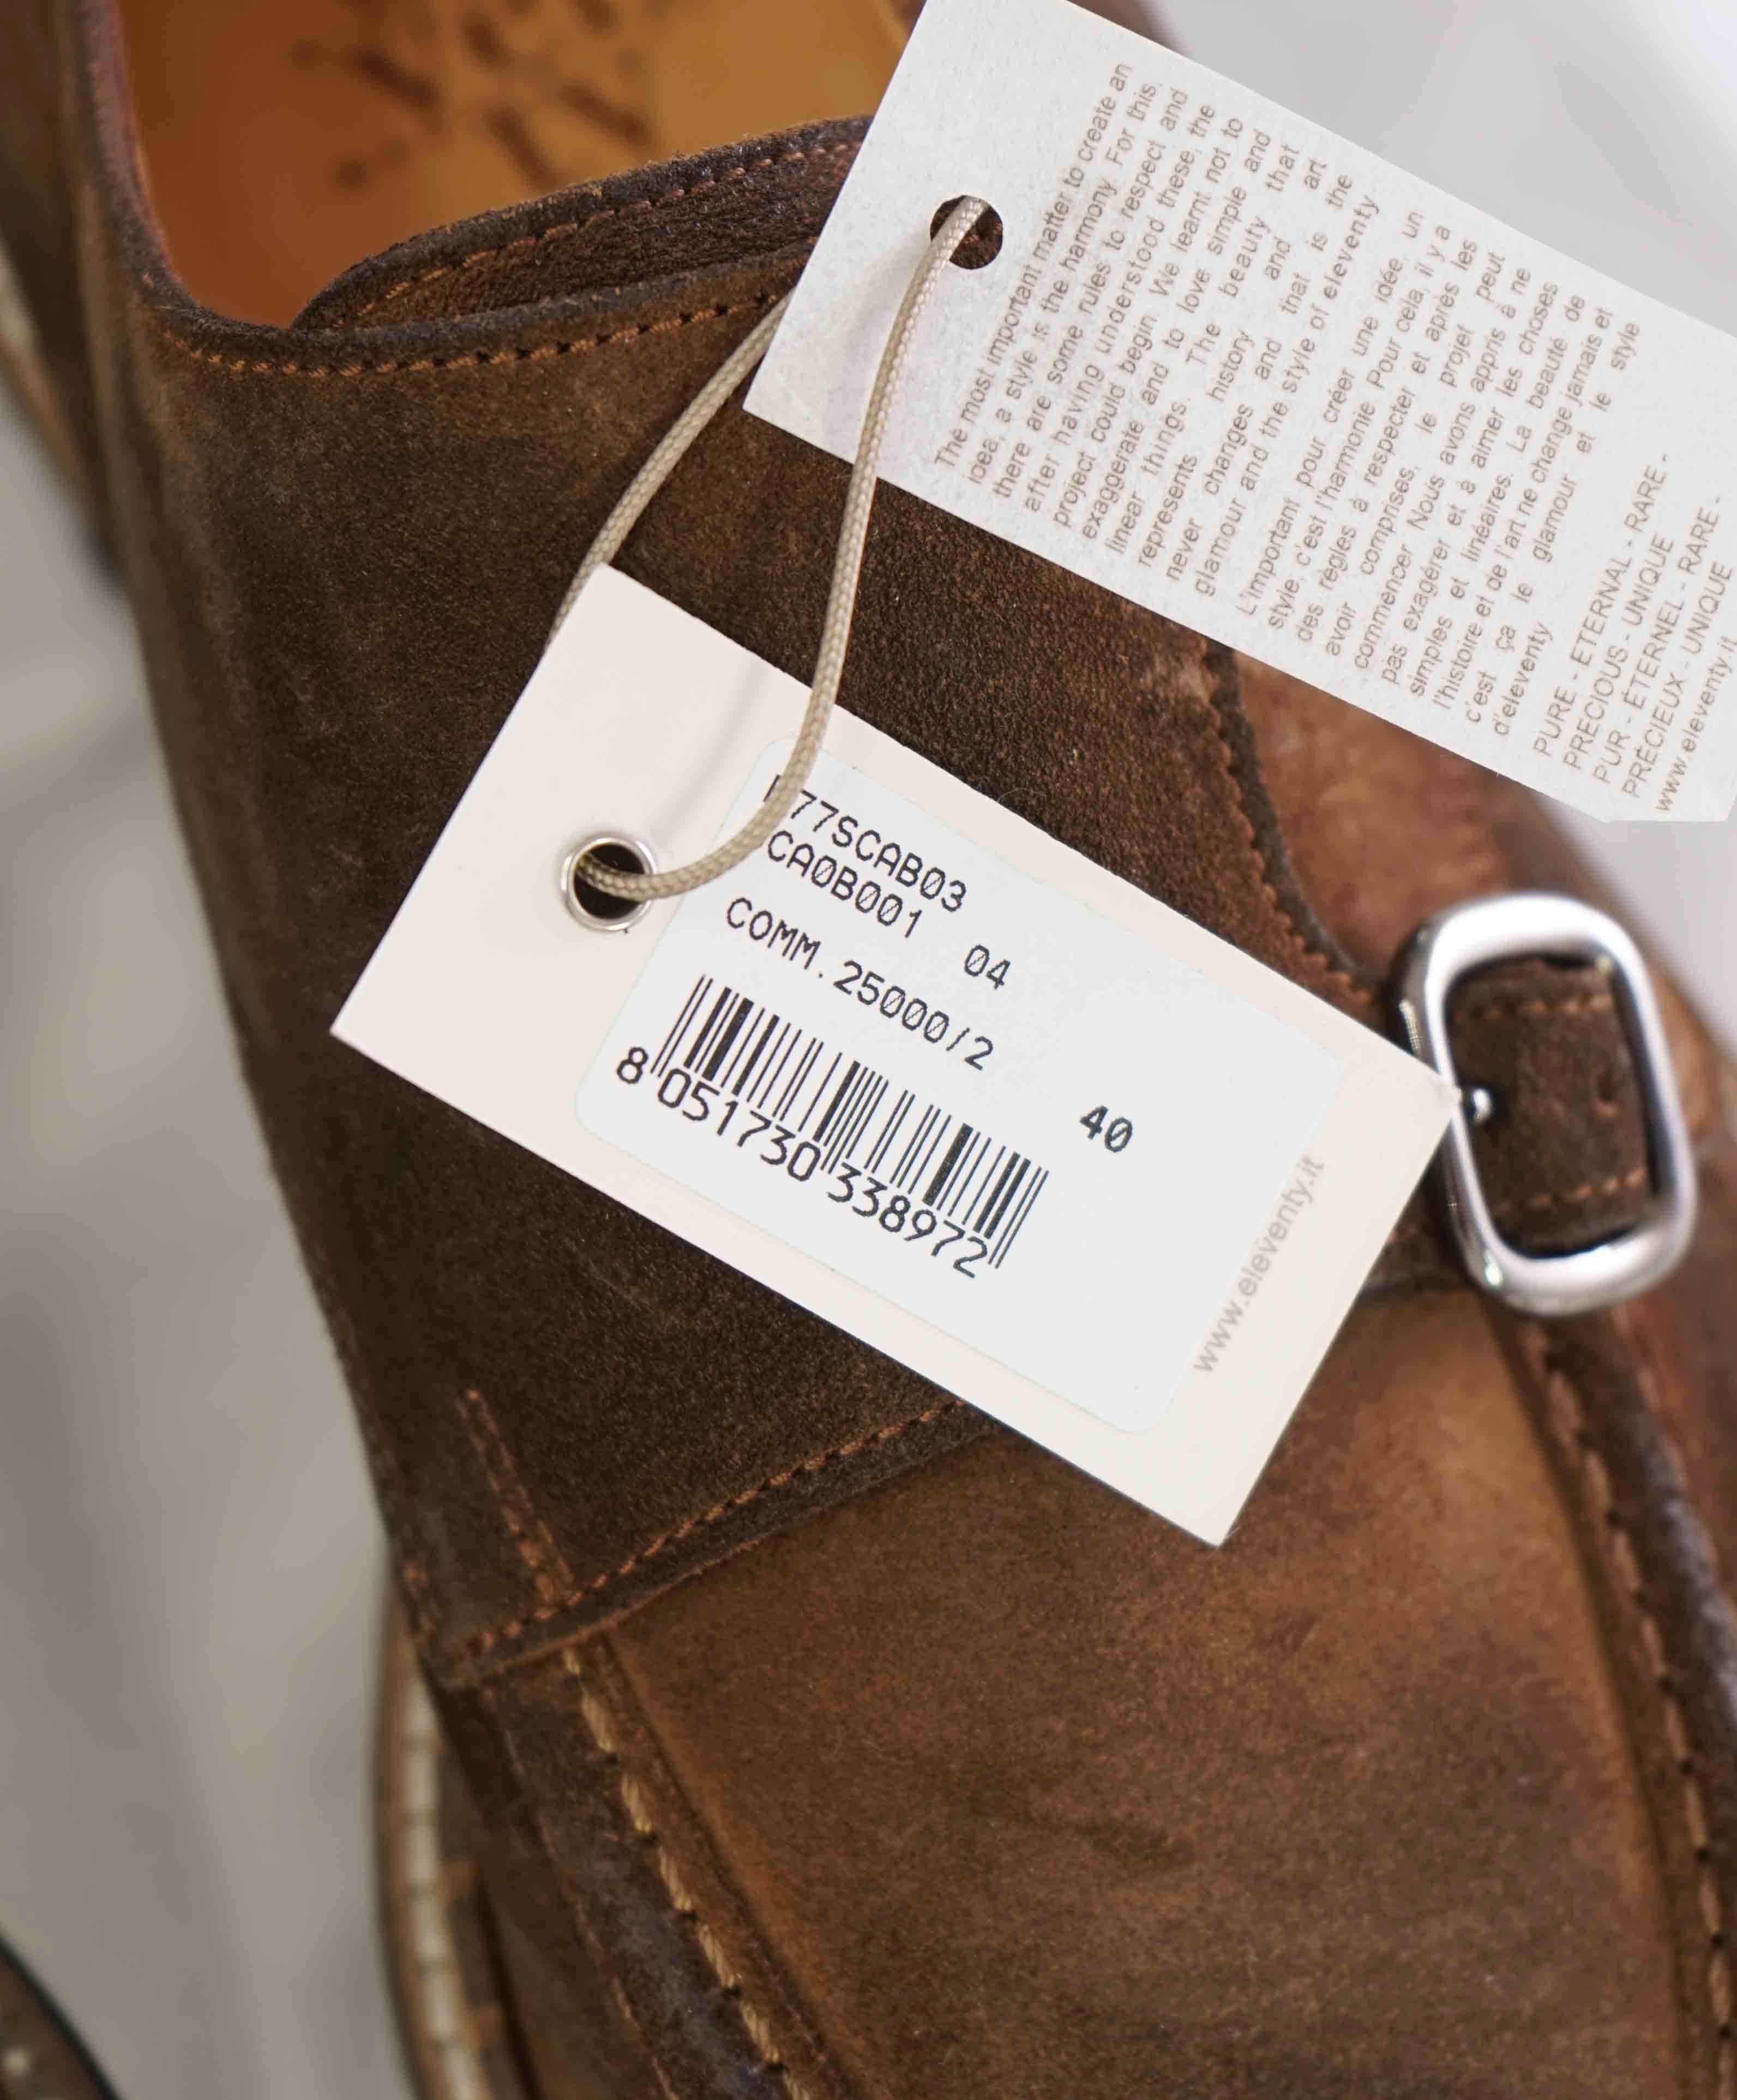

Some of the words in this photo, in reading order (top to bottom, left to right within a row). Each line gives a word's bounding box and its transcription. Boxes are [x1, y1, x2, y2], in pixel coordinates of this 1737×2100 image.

[934, 428, 968, 467] The
[959, 368, 995, 425] most
[986, 264, 1042, 367] important
[1032, 191, 1072, 261] matter
[1061, 166, 1085, 188] to
[1077, 96, 1116, 163] create
[1109, 63, 1132, 92] an
[1104, 127, 1135, 166] For
[1414, 262, 1434, 278] il
[1427, 244, 1445, 262] y
[1434, 225, 1451, 241] a
[992, 442, 1031, 499] there
[1026, 395, 1052, 432] are
[1047, 325, 1084, 385] some
[1078, 262, 1111, 315] rules
[1102, 230, 1126, 251] to
[1120, 140, 1167, 220] respect
[1159, 87, 1188, 131] and
[995, 407, 1013, 424] a
[1005, 350, 1038, 400] style
[1024, 453, 1060, 513] after
[1050, 364, 1105, 446] having
[1095, 215, 1165, 355] understood
[1187, 104, 1216, 138] the
[1031, 322, 1050, 341] is
[1039, 280, 1069, 314] the
[1053, 451, 1096, 529] project
[1090, 382, 1126, 443] could
[1149, 262, 1180, 297] We
[1169, 191, 1211, 253] learnt
[1205, 147, 1231, 184] not
[1220, 117, 1243, 139] to
[1081, 419, 1145, 539] exaggerate
[1141, 361, 1170, 406] and
[1162, 328, 1185, 350] to
[1176, 268, 1211, 314] love
[1207, 186, 1247, 256] simple
[1243, 128, 1271, 174] and
[1104, 490, 1144, 555] linear
[1186, 322, 1221, 365] The
[1218, 215, 1271, 299] beauty
[1265, 143, 1300, 193] that
[1138, 454, 1198, 568] represents
[1205, 329, 1255, 403] history
[1264, 236, 1292, 281] and
[1303, 159, 1327, 190] art
[1165, 517, 1202, 581] never
[1204, 404, 1254, 496] changes
[1254, 337, 1282, 381] and
[1278, 272, 1310, 315] that
[1305, 232, 1328, 252] is
[1325, 175, 1353, 209] the
[1295, 436, 1326, 489] pour
[1323, 367, 1355, 424] créer
[1351, 316, 1379, 357] une
[1401, 211, 1424, 239] un
[1366, 336, 1402, 389] Pour
[1406, 475, 1445, 531] Nous
[1439, 402, 1476, 466] avons
[1470, 328, 1506, 393] appris
[1510, 268, 1531, 295] ne
[1194, 497, 1246, 597] glamour
[1240, 445, 1270, 491] and
[1258, 401, 1289, 439] the
[1282, 338, 1316, 393] style
[1309, 303, 1330, 331] of
[1296, 604, 1324, 643] des
[1363, 386, 1416, 487] respecter
[1411, 352, 1431, 375] et
[1450, 239, 1478, 271] les
[1325, 601, 1356, 657] avoir
[1415, 413, 1437, 434] le
[1439, 324, 1473, 388] projet
[1475, 251, 1506, 303] peut
[1380, 644, 1408, 686] pas
[1403, 537, 1451, 632] exagérer
[1447, 503, 1466, 527] et
[1470, 406, 1504, 470] aimer
[1495, 367, 1523, 398] les
[1518, 283, 1558, 356] choses
[1409, 616, 1453, 697] simples
[1450, 577, 1470, 600] et
[1506, 425, 1532, 453] La
[1525, 338, 1567, 410] beauté
[1564, 295, 1585, 322] de
[1475, 595, 1495, 618] et
[1486, 563, 1507, 592] de
[1517, 488, 1538, 516] ne
[1531, 407, 1573, 483] change
[1565, 334, 1602, 407] jamais
[1595, 308, 1613, 329] et
[1510, 583, 1534, 604] le
[1532, 473, 1577, 563] glamour
[1576, 432, 1596, 454] et
[1589, 392, 1612, 412] le
[1610, 322, 1640, 371] style
[1532, 686, 1577, 757] PURE
[1569, 557, 1632, 667] ETERNAL
[1624, 465, 1667, 533] RARE
[1562, 645, 1628, 770] PRECIOUS
[1621, 533, 1674, 627] UNIQUE
[1592, 730, 1631, 784] PUR
[1677, 507, 1720, 575] RARE
[1680, 561, 1733, 655] UNIQUE
[763, 774, 968, 913] 77SCAB03
[767, 830, 922, 938] CA0B001
[964, 944, 1011, 989] 04
[616, 1047, 649, 1084] 8
[657, 1067, 821, 1182] 051730
[828, 1162, 988, 1279] 338972
[1080, 1106, 1133, 1153] 40
[1193, 1153, 1325, 1373] www.eleventy.it
